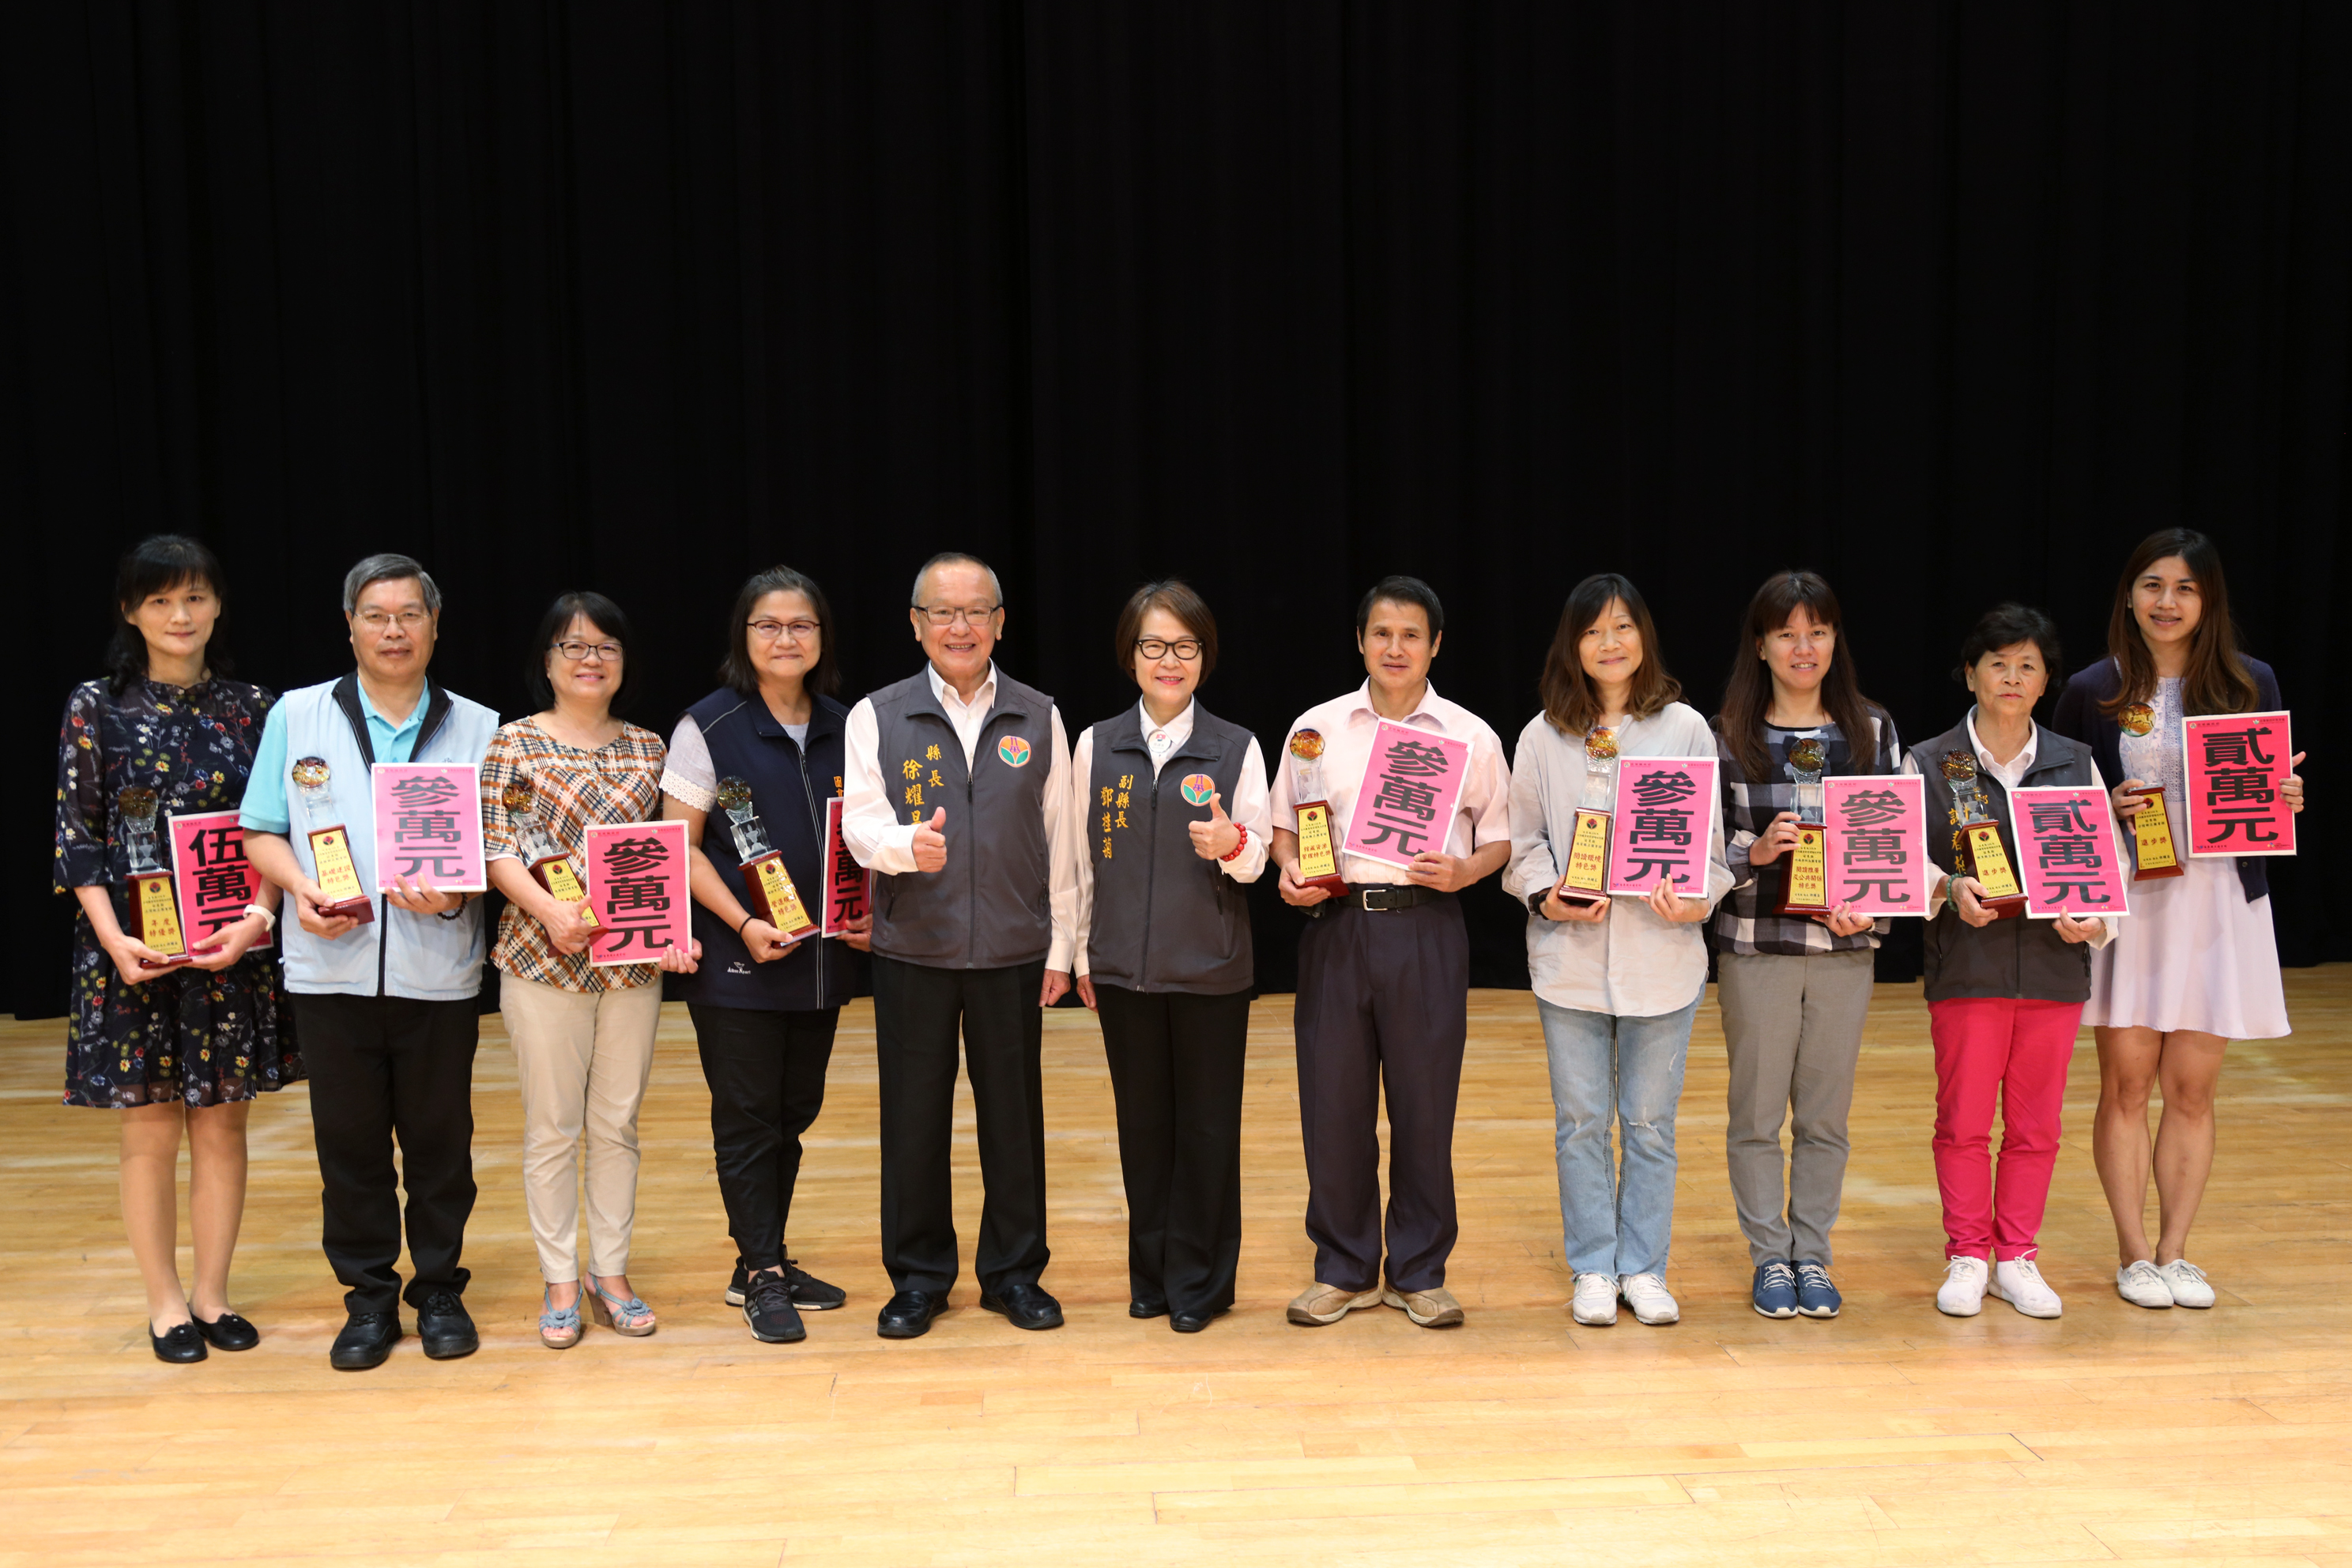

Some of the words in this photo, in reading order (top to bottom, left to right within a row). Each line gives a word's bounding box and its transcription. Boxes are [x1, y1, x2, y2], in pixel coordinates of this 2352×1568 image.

[925, 744, 944, 787] 縣長
[1115, 775, 1134, 828] 副縣長
[1360, 741, 1449, 857] 參萬元
[2203, 727, 2278, 843] 貳萬元
[390, 775, 466, 877] 參萬元
[834, 813, 863, 923] 萬元
[1623, 770, 1697, 884] 參萬元
[1839, 790, 1910, 903] 參萬元
[2028, 799, 2111, 905] 貳萬元
[602, 836, 674, 952] 參萬元
